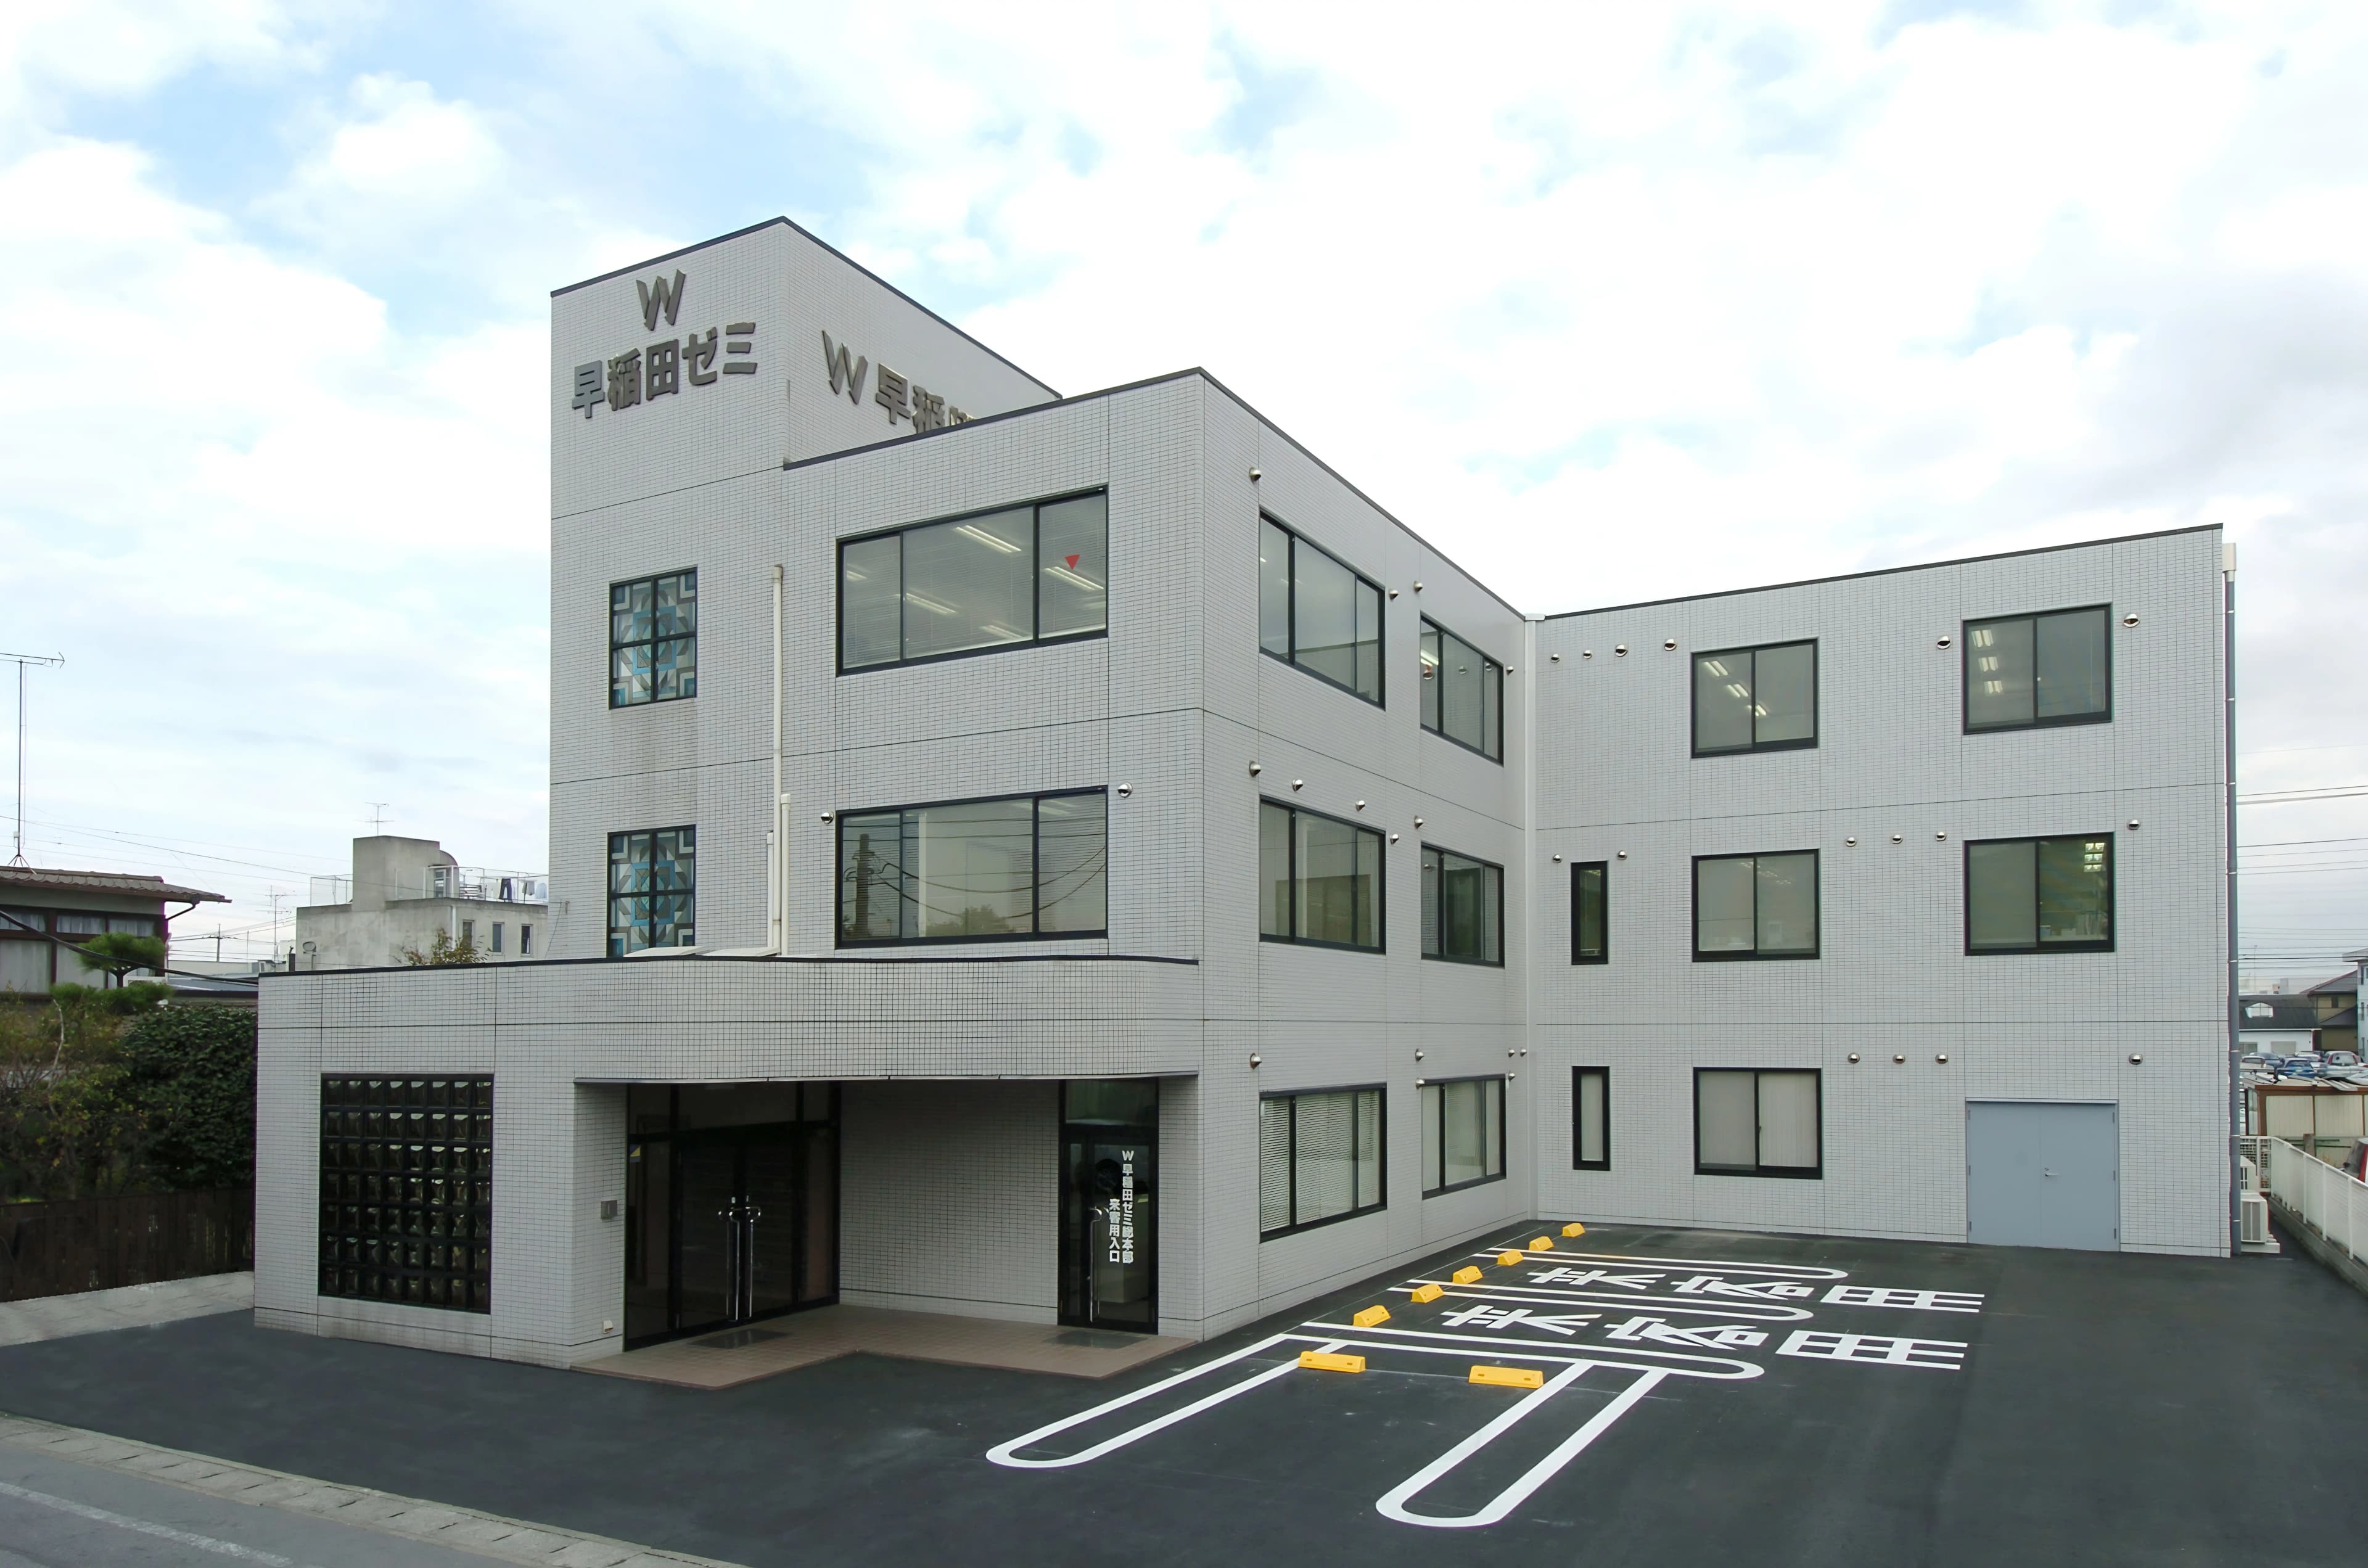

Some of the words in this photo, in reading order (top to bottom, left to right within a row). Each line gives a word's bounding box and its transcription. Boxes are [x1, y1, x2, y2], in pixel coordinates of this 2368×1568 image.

[636, 269, 686, 331] W
[572, 322, 758, 419] 早稲田ゼミ
